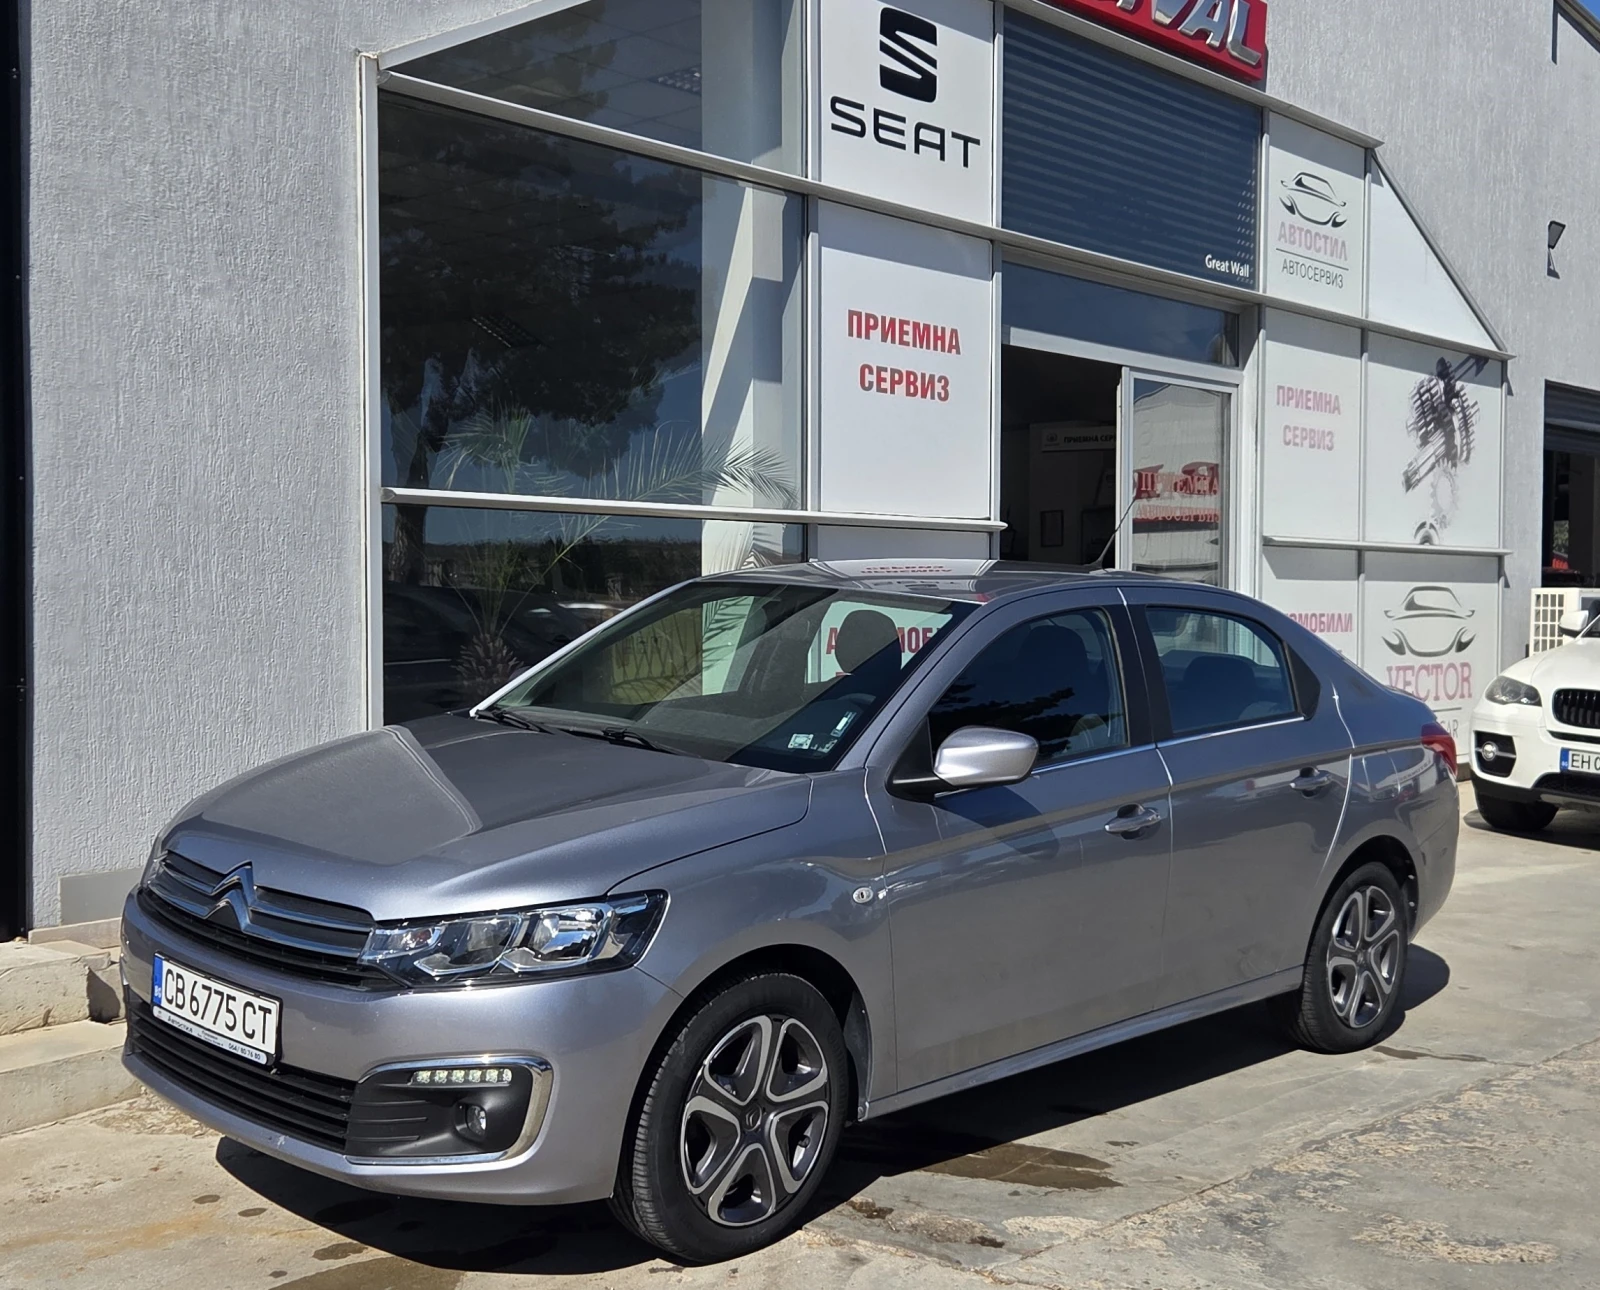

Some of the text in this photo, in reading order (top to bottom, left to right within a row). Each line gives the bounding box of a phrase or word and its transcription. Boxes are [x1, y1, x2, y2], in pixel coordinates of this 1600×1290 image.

[830, 95, 981, 169] SEAT
[1277, 221, 1348, 262] АВТОСТИЛ
[1204, 253, 1250, 278] Great Wall
[1281, 257, 1344, 289] АВТОСЕРВИЗ
[847, 308, 962, 356] ПРИЕМНА
[858, 362, 951, 403] СЕРВИЗ
[1276, 385, 1341, 416] ПРИЕМНА
[1282, 424, 1335, 452] СЕРВИЗ
[1386, 661, 1473, 702] VECTOR
